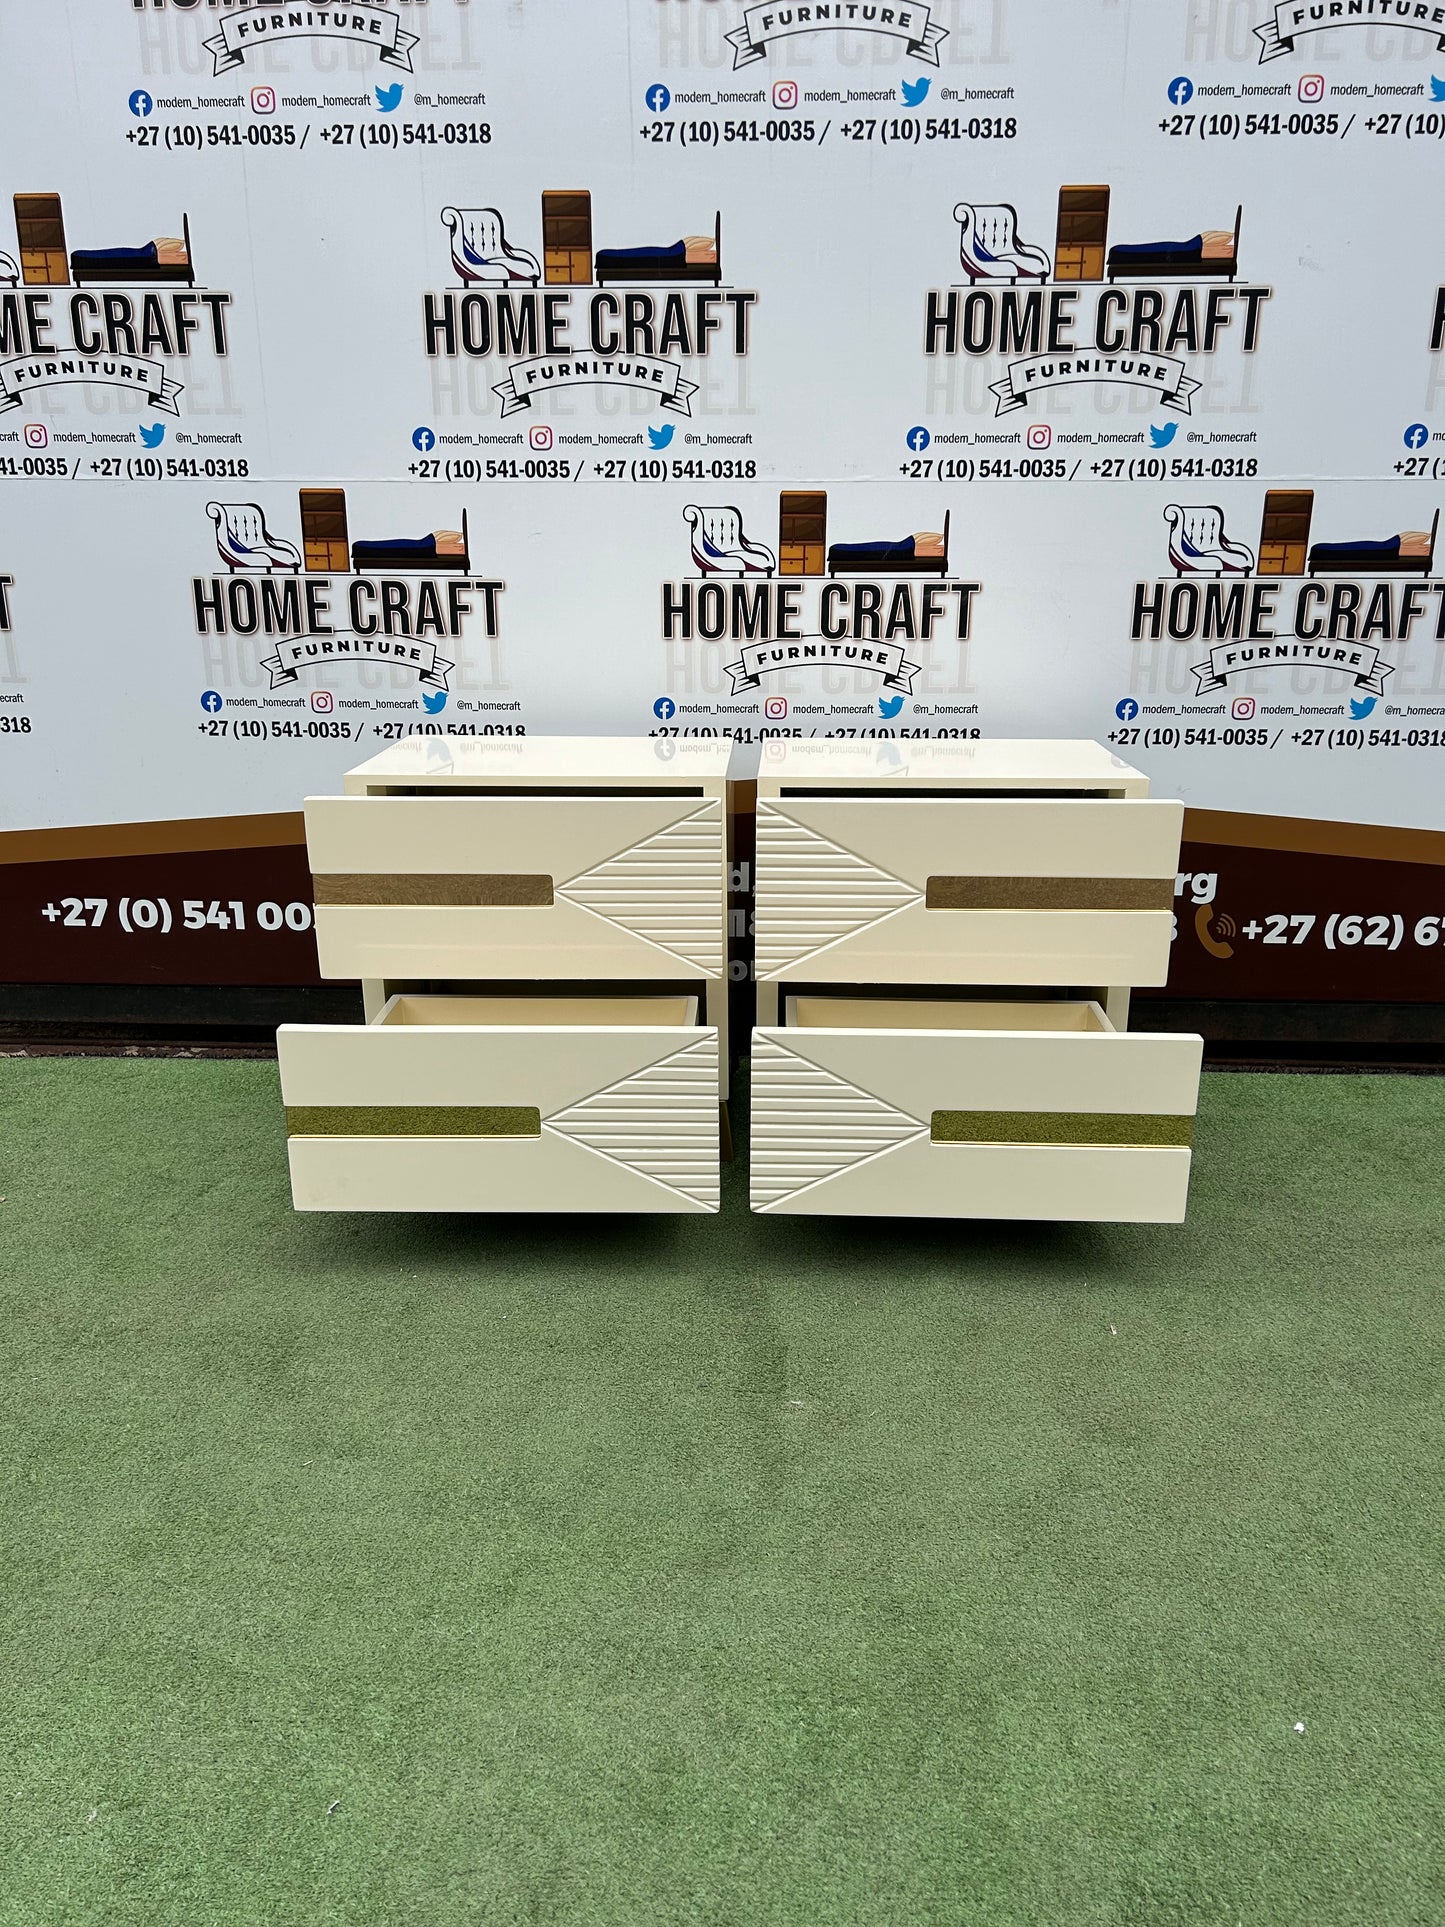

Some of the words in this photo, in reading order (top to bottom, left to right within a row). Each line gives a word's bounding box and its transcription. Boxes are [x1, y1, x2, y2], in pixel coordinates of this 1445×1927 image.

[238, 12, 381, 37] FURNITURE
[763, 5, 911, 34] FURNITURE
[414, 93, 485, 107] @m_homecraft
[941, 87, 1014, 101] @m_homecraft
[126, 126, 159, 146] +27
[165, 126, 202, 150] (10)
[208, 125, 295, 145] 541-0035
[320, 124, 354, 144] +27
[360, 124, 398, 149] (10)
[403, 123, 491, 144] 541-0318
[640, 122, 675, 142] +27
[680, 121, 719, 147] (10)
[724, 120, 815, 141] 541-0035
[841, 120, 876, 140] +27
[881, 119, 920, 145] (10)
[925, 118, 1016, 139] 541-0318
[1159, 115, 1195, 135] +27
[1200, 114, 1240, 140] (10)
[1245, 114, 1338, 135] 541-0035
[1365, 114, 1402, 134] +27
[0, 292, 56, 356] ME
[70, 292, 231, 356] CRAFT
[423, 291, 573, 356] HOME
[589, 291, 757, 355] CRAFT
[924, 290, 1078, 354] HOME
[1095, 287, 1270, 353] CRAFT
[15, 361, 148, 382] FURNITURE
[526, 362, 663, 383] FURNITURE
[1026, 360, 1167, 382] FURNITURE
[176, 433, 242, 443] @m_homecraft
[685, 434, 752, 444] @m_homecraft
[1187, 432, 1256, 444] @m_homecraft
[0, 457, 67, 475] 41-0035
[90, 458, 121, 476] +27
[127, 459, 162, 480] (10)
[167, 459, 248, 477] 541-0318
[408, 460, 440, 477] +27
[446, 460, 481, 482] (10)
[486, 460, 570, 478] 541-0035
[594, 460, 626, 478] +27
[631, 460, 667, 482] (10)
[672, 460, 756, 478] 541-0318
[900, 460, 933, 477] +27
[938, 460, 974, 481] (10)
[979, 459, 1066, 477] 541-0035
[1090, 459, 1124, 477] +27
[1129, 459, 1166, 481] (10)
[1171, 459, 1257, 477] 541-0318
[1394, 458, 1429, 476] +27
[192, 578, 334, 635] HOME
[350, 579, 504, 637] CRAFT
[662, 582, 803, 640] HOME
[820, 582, 981, 641] CRAFT
[1130, 582, 1279, 640] HOME
[292, 641, 420, 660] FURNITURE
[757, 646, 888, 664] FURNITURE
[1227, 646, 1361, 665] FURNITURE
[457, 700, 520, 711] @m_homecraft
[913, 704, 978, 715] @m_homecraft
[1385, 705, 1445, 717] @m_homecra
[198, 720, 228, 736] +27
[234, 721, 267, 740] (10)
[272, 721, 351, 738] 541-0035
[373, 723, 403, 739] +27
[408, 723, 443, 735] (10)
[447, 724, 526, 736] 541-0318
[1108, 728, 1140, 744] +27
[1144, 728, 1180, 748] (10)
[1184, 729, 1268, 745] 541-0035
[1291, 729, 1324, 745] +27
[1328, 729, 1364, 750] (10)
[42, 898, 107, 926] +27
[119, 898, 172, 933] (0)
[183, 901, 245, 929] 541
[257, 902, 315, 931] 00
[1243, 915, 1315, 944] +27
[1325, 914, 1403, 950] (62)
